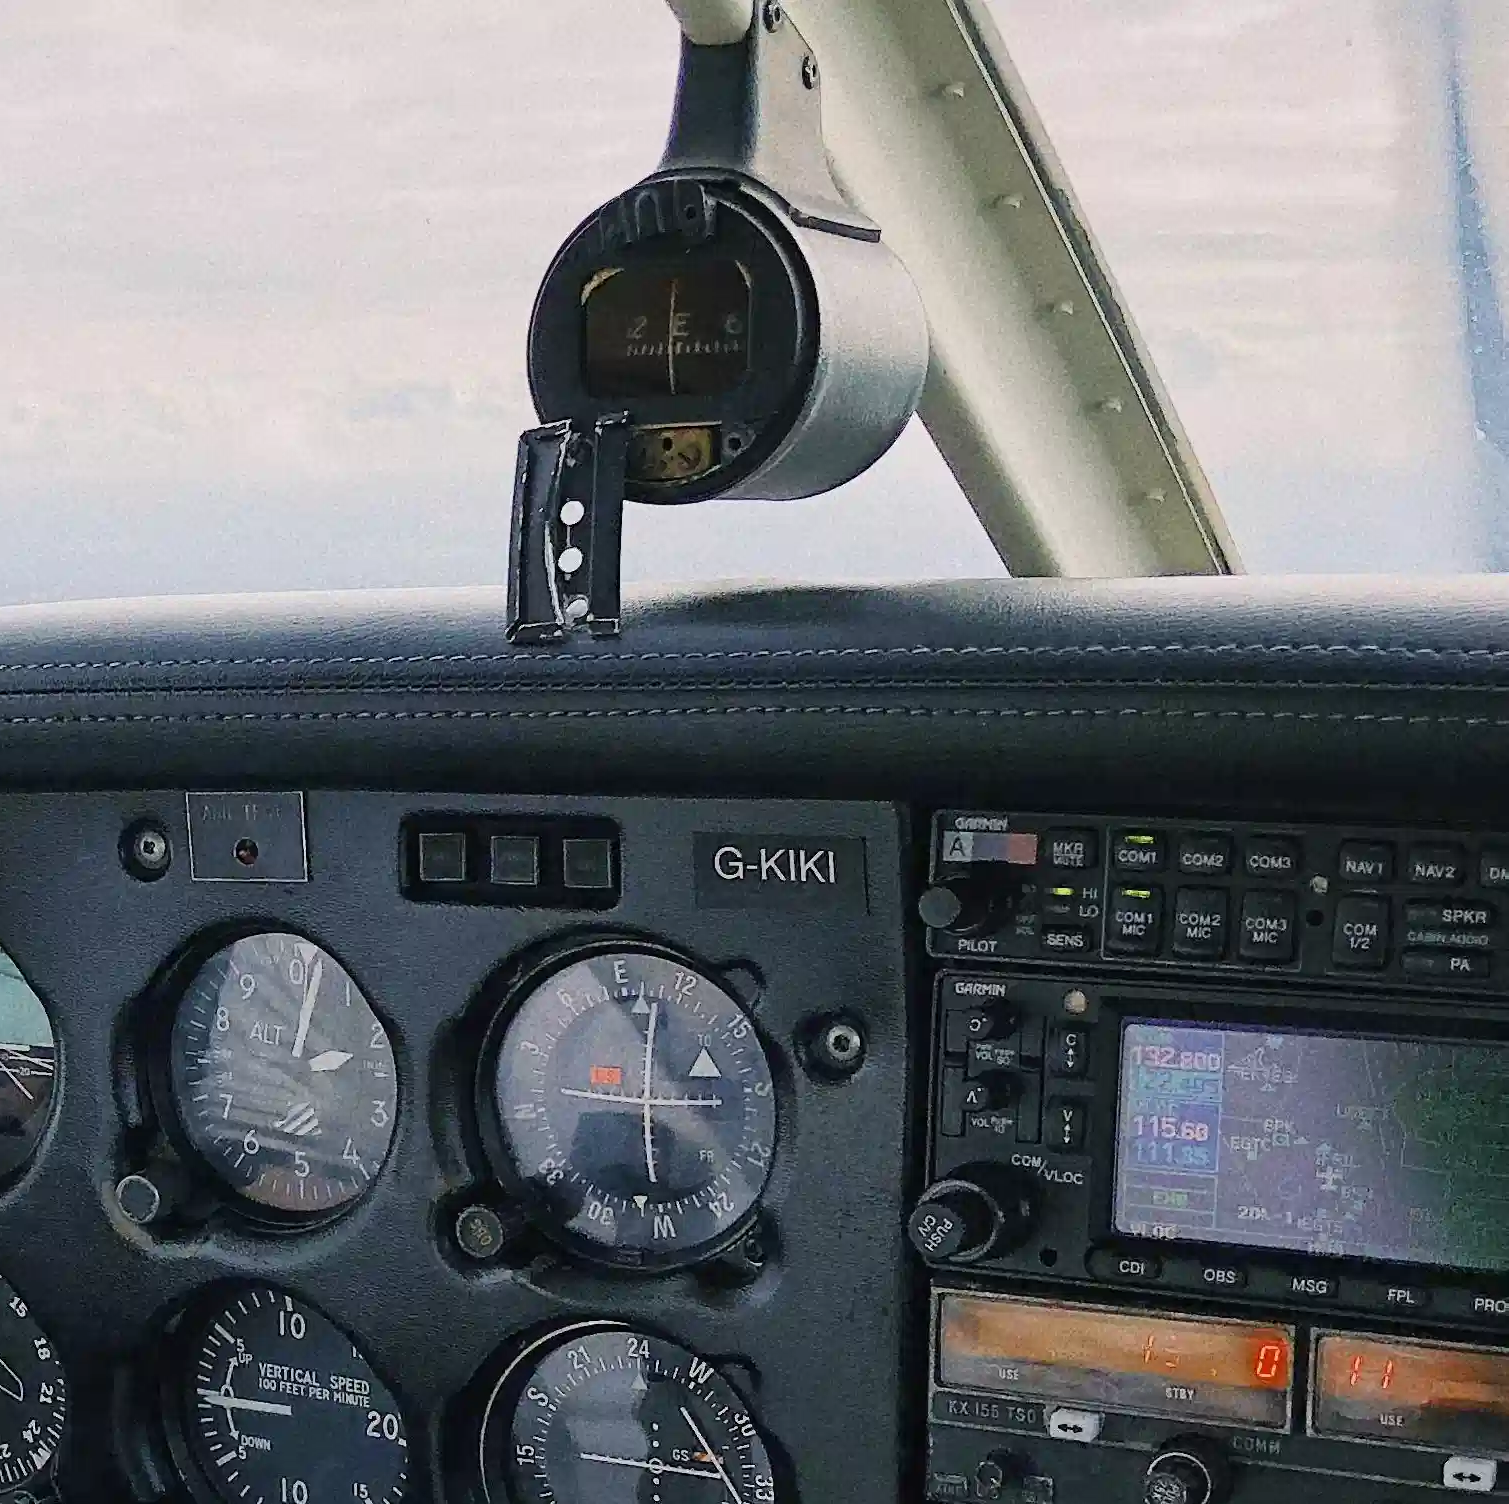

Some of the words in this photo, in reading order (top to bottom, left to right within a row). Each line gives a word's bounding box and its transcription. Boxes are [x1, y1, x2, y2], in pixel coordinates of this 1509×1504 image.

[954, 816, 1009, 831] GARMIN
[949, 836, 966, 856] A
[1053, 842, 1084, 854] MKR
[1118, 850, 1157, 864] COM1
[1182, 852, 1223, 867] COM2
[1250, 855, 1291, 869] COM3
[714, 845, 838, 884] G-KIKI
[1414, 863, 1457, 879] NAV2
[1082, 887, 1099, 899] HI
[1079, 905, 1099, 917] LO
[1115, 911, 1155, 924] COM1
[1442, 909, 1488, 924] SPKR
[1178, 913, 1221, 926] COM2
[1245, 916, 1288, 931] COM3
[1122, 924, 1146, 936] MIC
[1186, 926, 1211, 939] MIC
[1343, 923, 1378, 937] COM
[1046, 934, 1084, 948] SENS
[1252, 931, 1279, 944] MIC
[1349, 936, 1371, 950] 1/2
[958, 939, 998, 953] PILOT
[1450, 958, 1471, 971] PA
[955, 982, 1006, 997] GARMIN
[249, 1020, 286, 1045] ALT
[925, 1218, 953, 1251] PUSH
[1119, 1259, 1145, 1275] CDI
[1204, 1267, 1236, 1284] OBS
[1292, 1277, 1328, 1294] MSG
[1387, 1288, 1416, 1304] FPL
[239, 1352, 253, 1365] UP
[258, 1363, 320, 1387] VERTICAL
[329, 1375, 371, 1395] SPEED
[999, 1368, 1019, 1381] USE
[258, 1377, 277, 1392] 100
[279, 1381, 307, 1398] FEET
[308, 1385, 330, 1402] PER
[333, 1389, 371, 1409] MINUTE
[1165, 1387, 1195, 1401] STBY
[947, 1400, 968, 1414] KX
[1006, 1407, 1037, 1424] TSO
[366, 1410, 400, 1440] 20
[1380, 1414, 1404, 1427] USE
[240, 1434, 271, 1451] DOWN
[1233, 1435, 1282, 1455] COMM
[672, 1449, 689, 1462] GS
